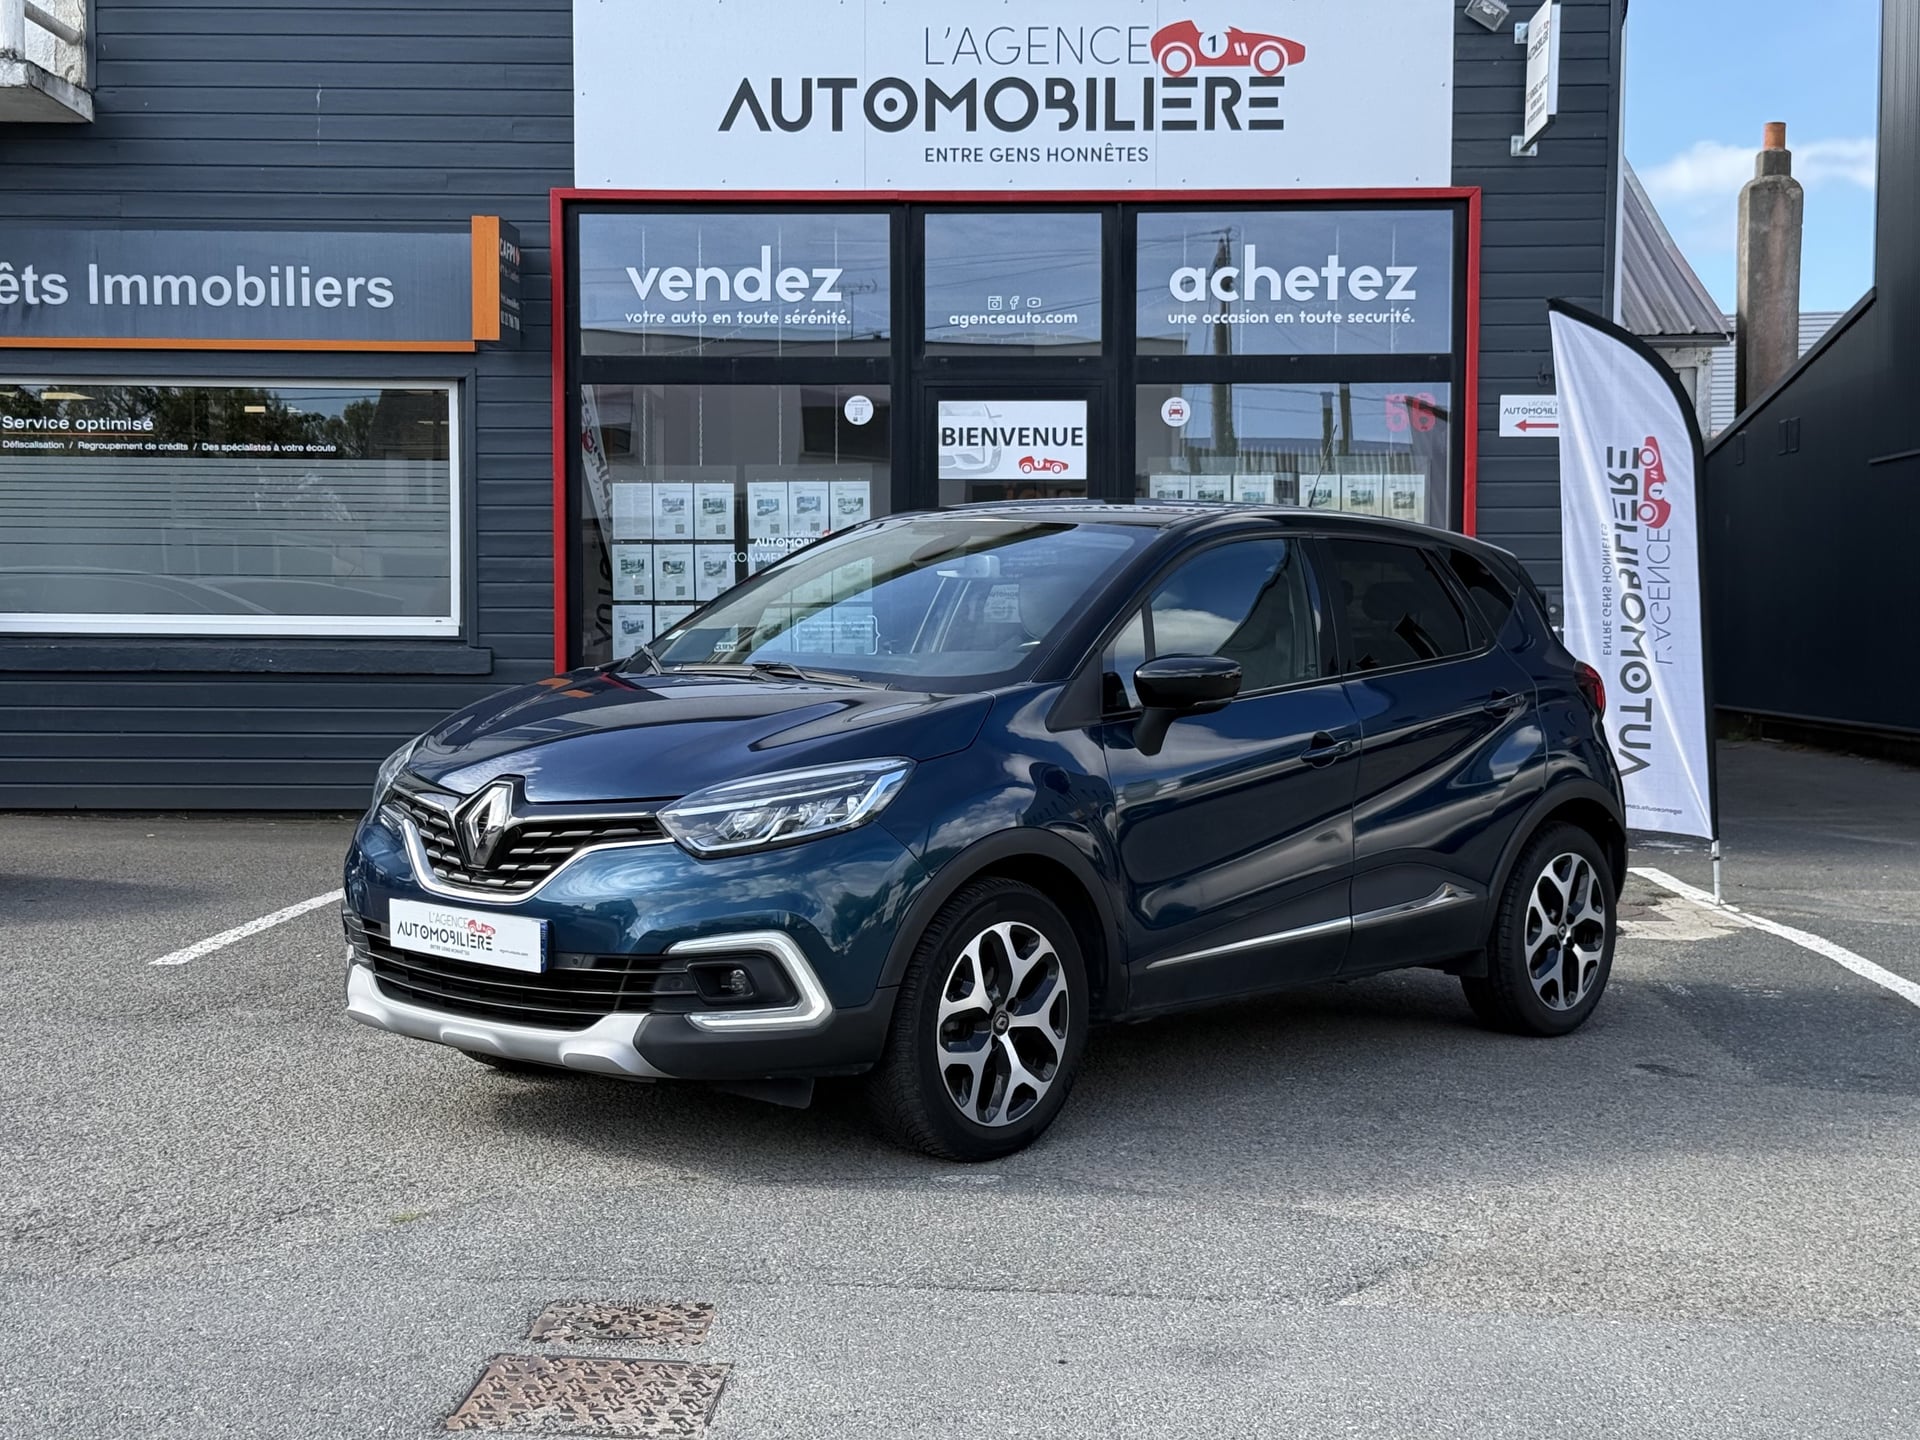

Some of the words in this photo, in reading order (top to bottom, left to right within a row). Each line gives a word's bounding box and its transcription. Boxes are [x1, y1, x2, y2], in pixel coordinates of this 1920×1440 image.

[923, 25, 1151, 66] L'AGENCE
[717, 76, 1285, 132] AUTOMOBILIERE
[924, 146, 984, 163] ENTRE
[989, 146, 1041, 163] GENS
[1046, 141, 1149, 163] HONNÊTES
[625, 245, 843, 302] vendez
[1169, 244, 1418, 302] achetez
[88, 263, 395, 309] Immobiliers
[625, 310, 666, 325] votre
[671, 311, 707, 325] auto
[712, 312, 731, 325] en
[736, 311, 779, 325] toute
[784, 308, 851, 325] sérénité.
[949, 312, 1078, 329] agenceauto.com
[1167, 311, 1198, 325] une
[1202, 309, 1270, 325] occasion
[1274, 311, 1294, 324] en
[1299, 309, 1343, 324] toute
[1347, 306, 1416, 325] securité.
[2, 415, 70, 430] Service
[75, 416, 154, 433] optimisé
[2, 440, 65, 450] Défiscalisation
[78, 440, 145, 452] Regroupement
[145, 441, 157, 451] de
[158, 441, 189, 452] crédits
[202, 442, 219, 452] Des
[221, 442, 272, 453] spécialistes
[281, 444, 305, 453] votre
[306, 443, 337, 453] écoute
[941, 426, 1084, 447] BIENVENUE
[428, 911, 469, 930] L'AGENCE
[396, 920, 494, 951] AUTOMOBILIERE
